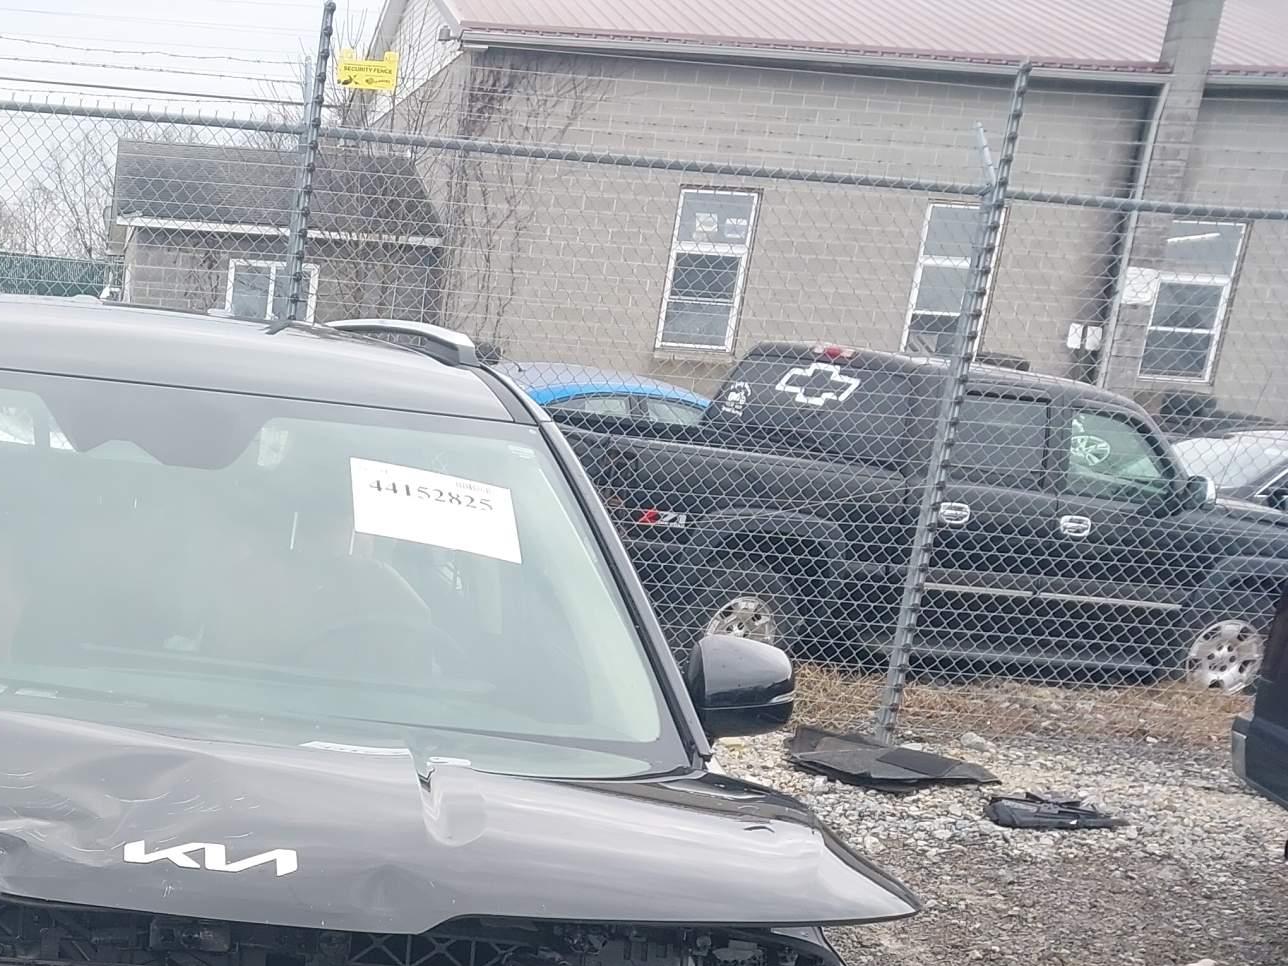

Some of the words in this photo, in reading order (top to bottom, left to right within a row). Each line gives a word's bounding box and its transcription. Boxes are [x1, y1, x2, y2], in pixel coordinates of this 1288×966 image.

[343, 65, 373, 73] SECURITY
[368, 479, 494, 512] 44152825
[123, 839, 299, 877] KIA
